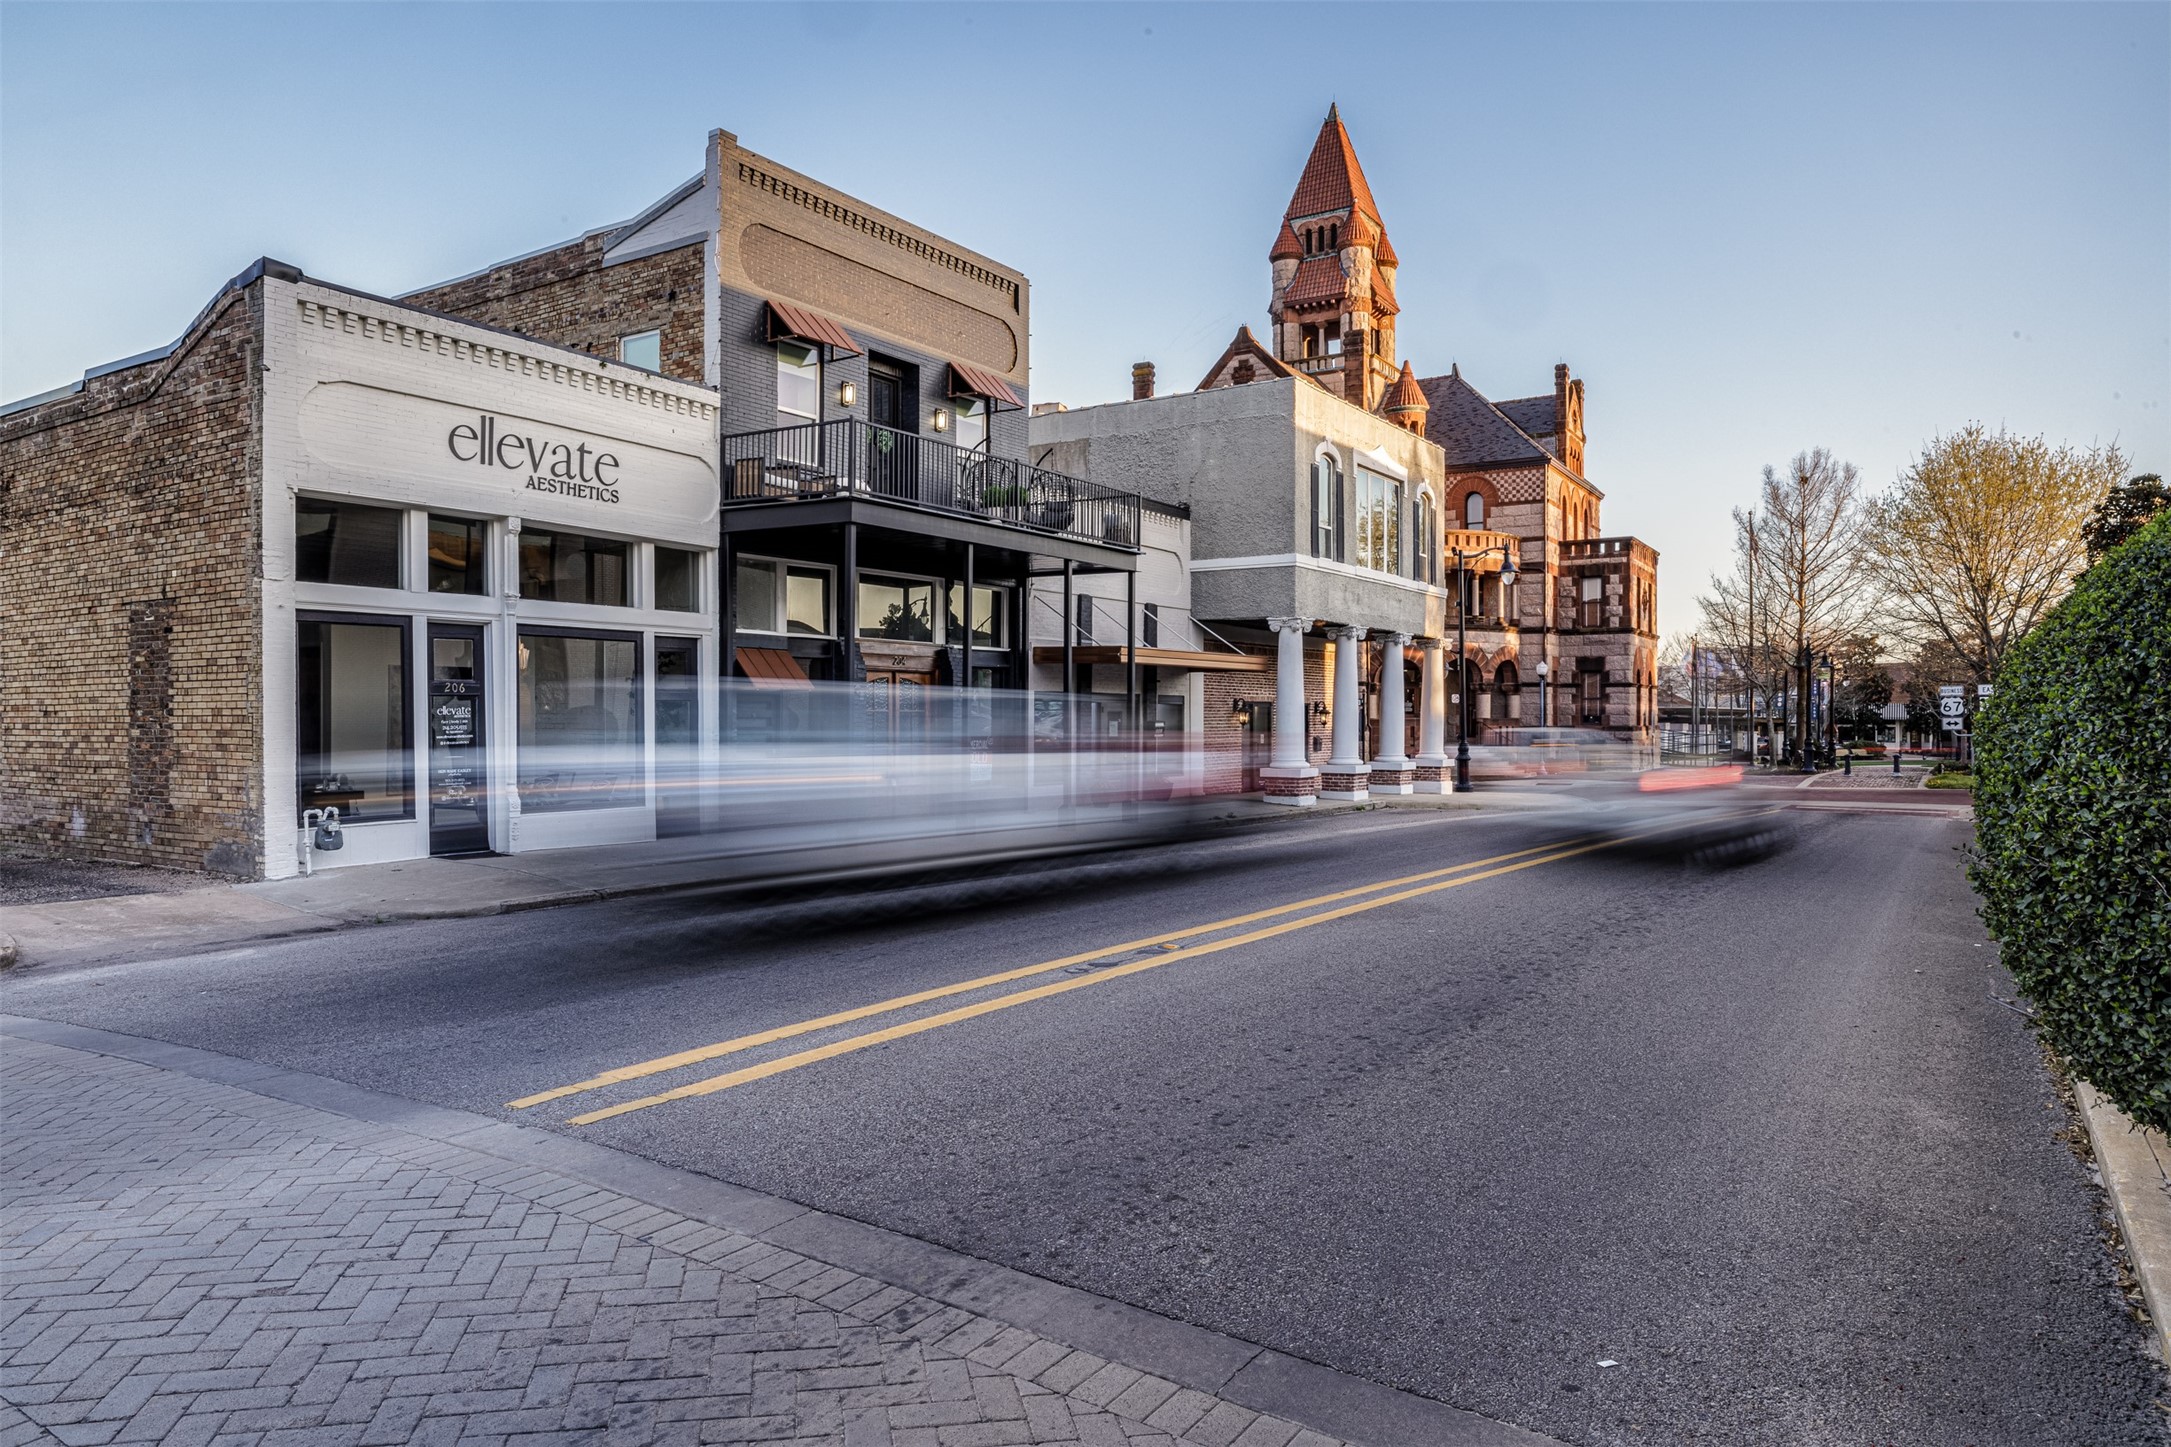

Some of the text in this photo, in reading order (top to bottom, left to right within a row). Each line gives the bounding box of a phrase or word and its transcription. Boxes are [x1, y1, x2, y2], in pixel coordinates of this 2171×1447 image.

[448, 415, 620, 487] ellevate
[525, 475, 620, 504] AESTHETICS
[444, 682, 466, 693] 206
[1943, 701, 1962, 712] 67
